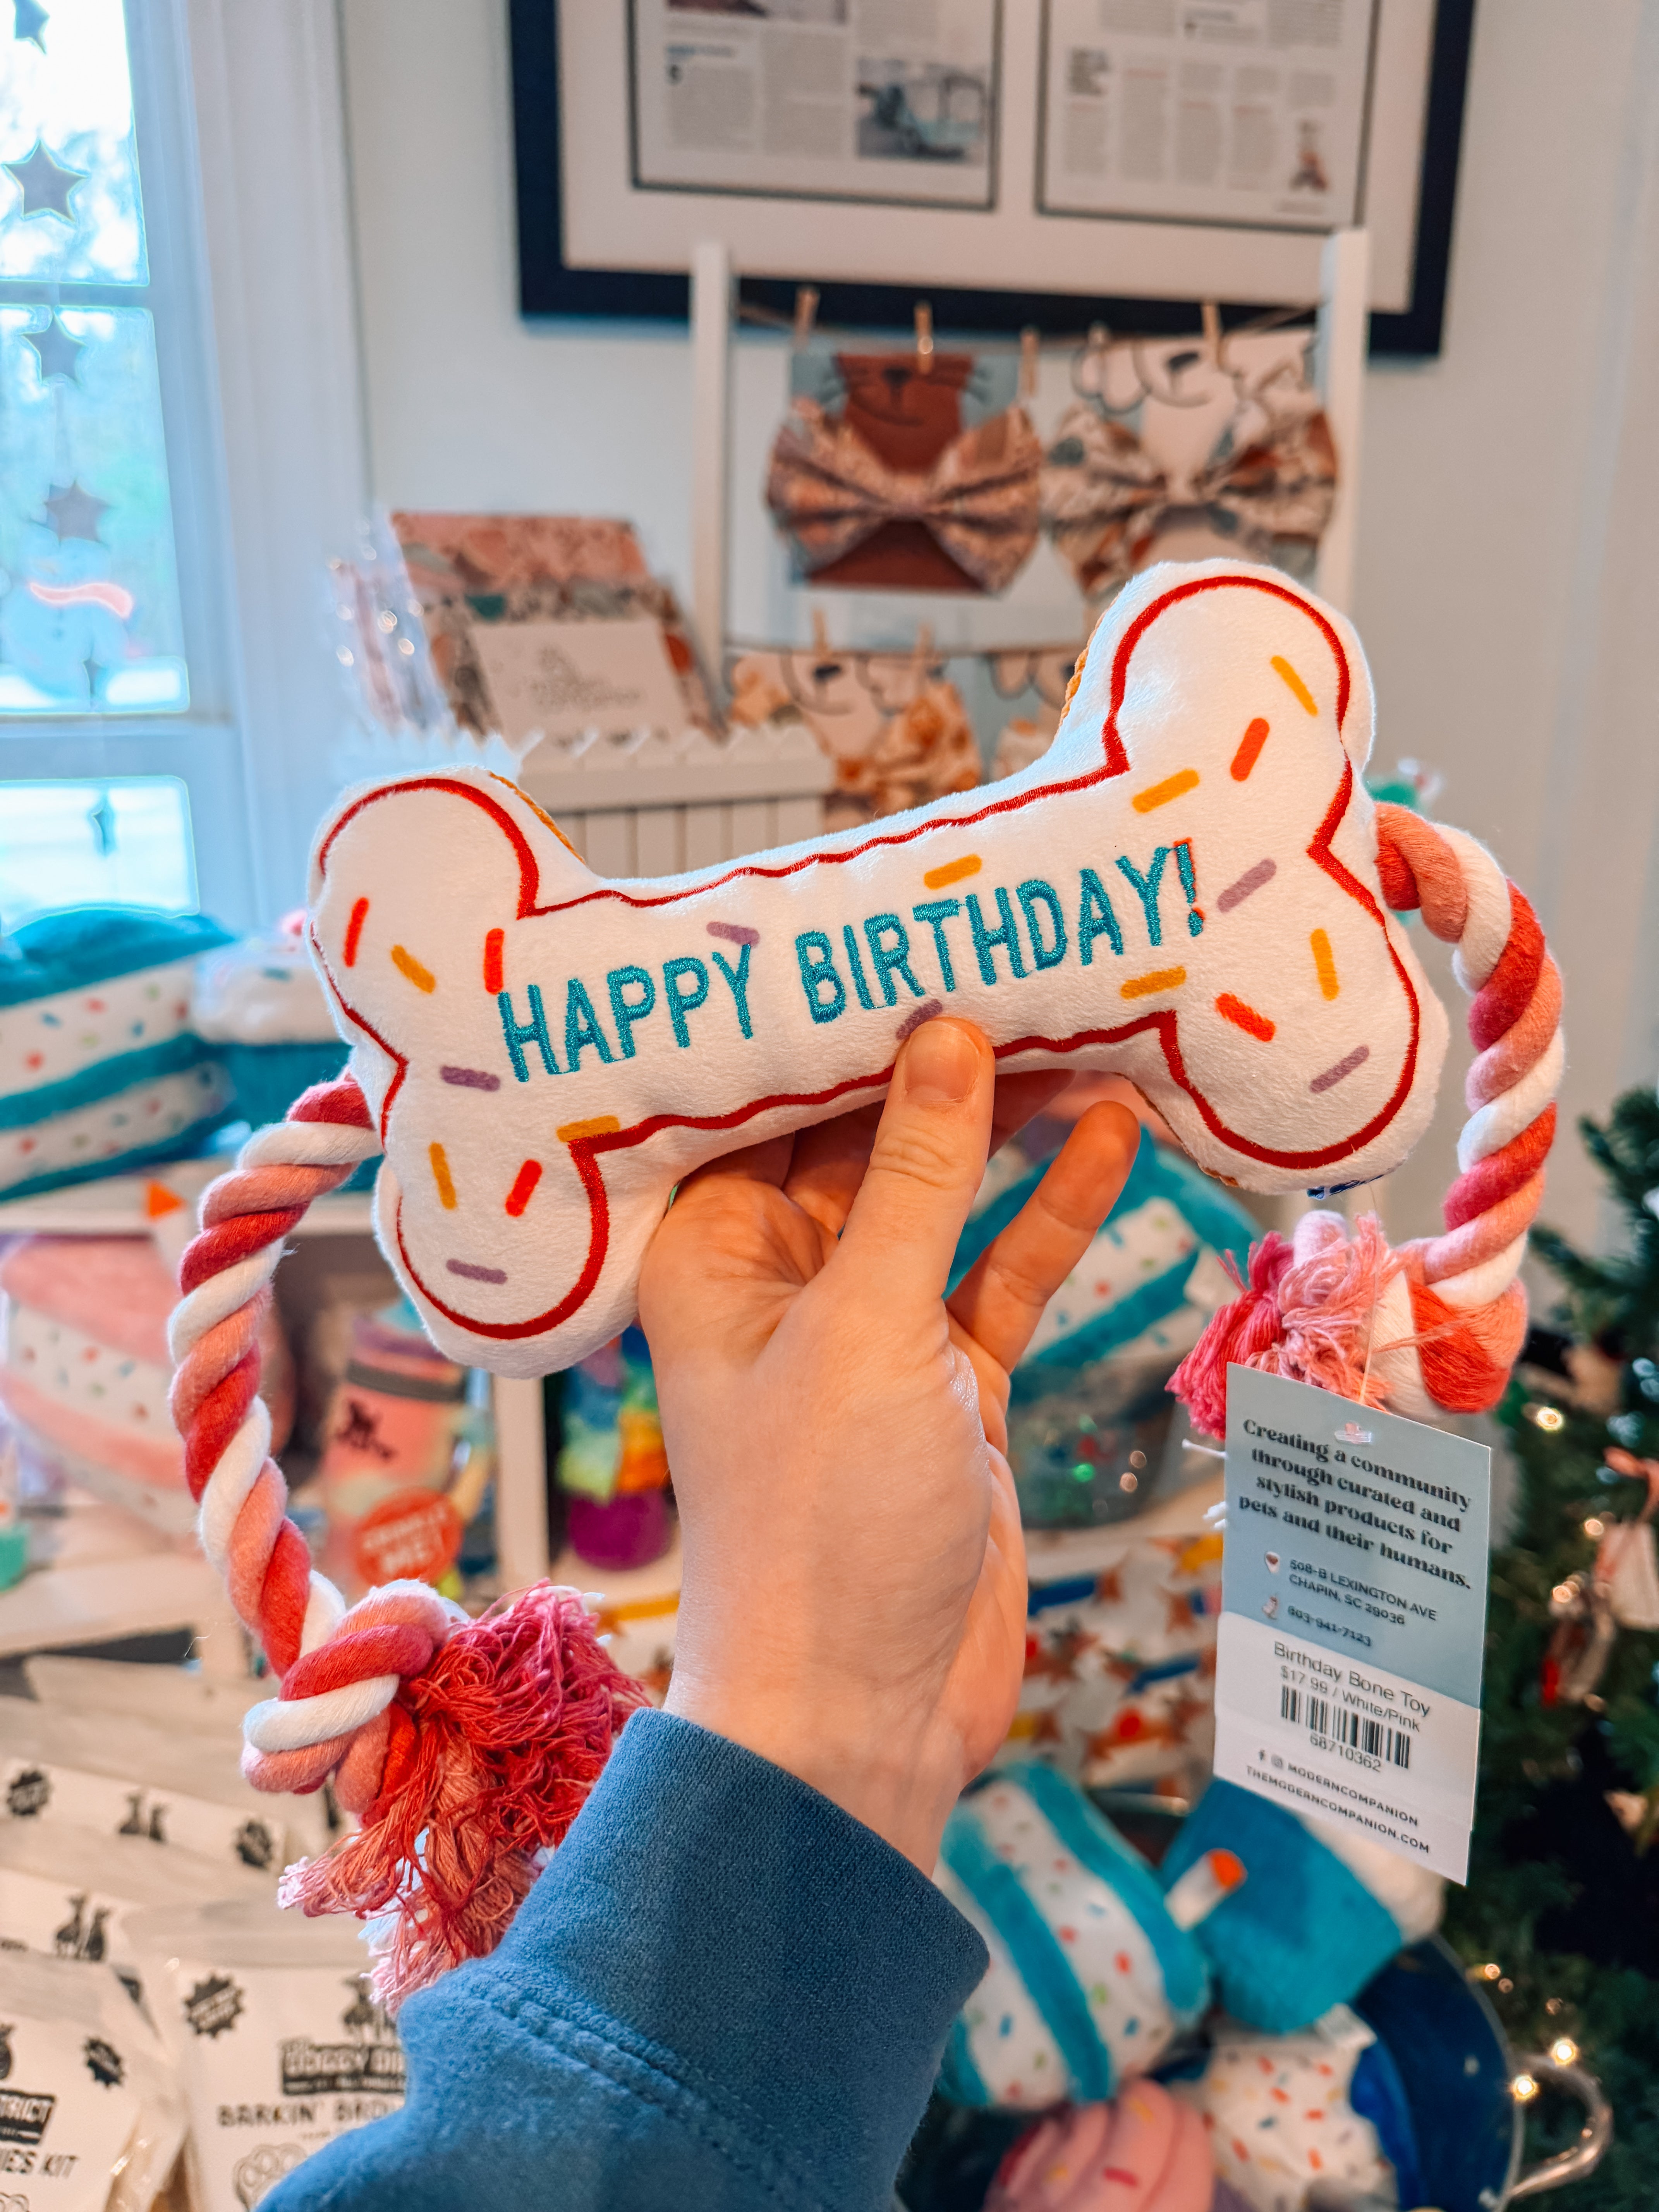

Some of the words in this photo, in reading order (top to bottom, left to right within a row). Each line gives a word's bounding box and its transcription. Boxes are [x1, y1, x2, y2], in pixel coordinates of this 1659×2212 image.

[497, 944, 752, 1083] HAPPY
[794, 837, 1205, 1025] BIRTHDAY!
[1243, 1419, 1329, 1462] Creating
[1334, 1449, 1346, 1463] a
[1351, 1455, 1471, 1512] community
[1251, 1448, 1332, 1486] through
[1337, 1476, 1415, 1515] curated
[1420, 1504, 1460, 1532] and
[1239, 1496, 1278, 1518] pets
[1282, 1510, 1319, 1533] and
[1325, 1523, 1374, 1550] their
[1380, 1542, 1471, 1589] humans.
[1256, 1475, 1319, 1507] stylish
[1325, 1499, 1415, 1540] products
[1420, 1529, 1453, 1554] for
[1289, 1559, 1326, 1579] 508-B
[1331, 1571, 1407, 1609] LEXINGTON
[1410, 1602, 1437, 1620] AVE
[1289, 1574, 1341, 1602] CHAPIN,
[1344, 1593, 1362, 1609] SC
[1274, 1641, 1342, 1682] Birthday
[1349, 1670, 1394, 1700] Bone
[1400, 1690, 1430, 1717] Toy
[1281, 1665, 1328, 1693] $1799
[1342, 1689, 1420, 1732] White/Pink
[1310, 1731, 1381, 1773] 68710362
[1247, 1765, 1429, 1853] THEMODERNCOMPANION.COM
[1288, 1762, 1418, 1826] MODERNCOMPANION
[41, 2152, 79, 2179] KIT
